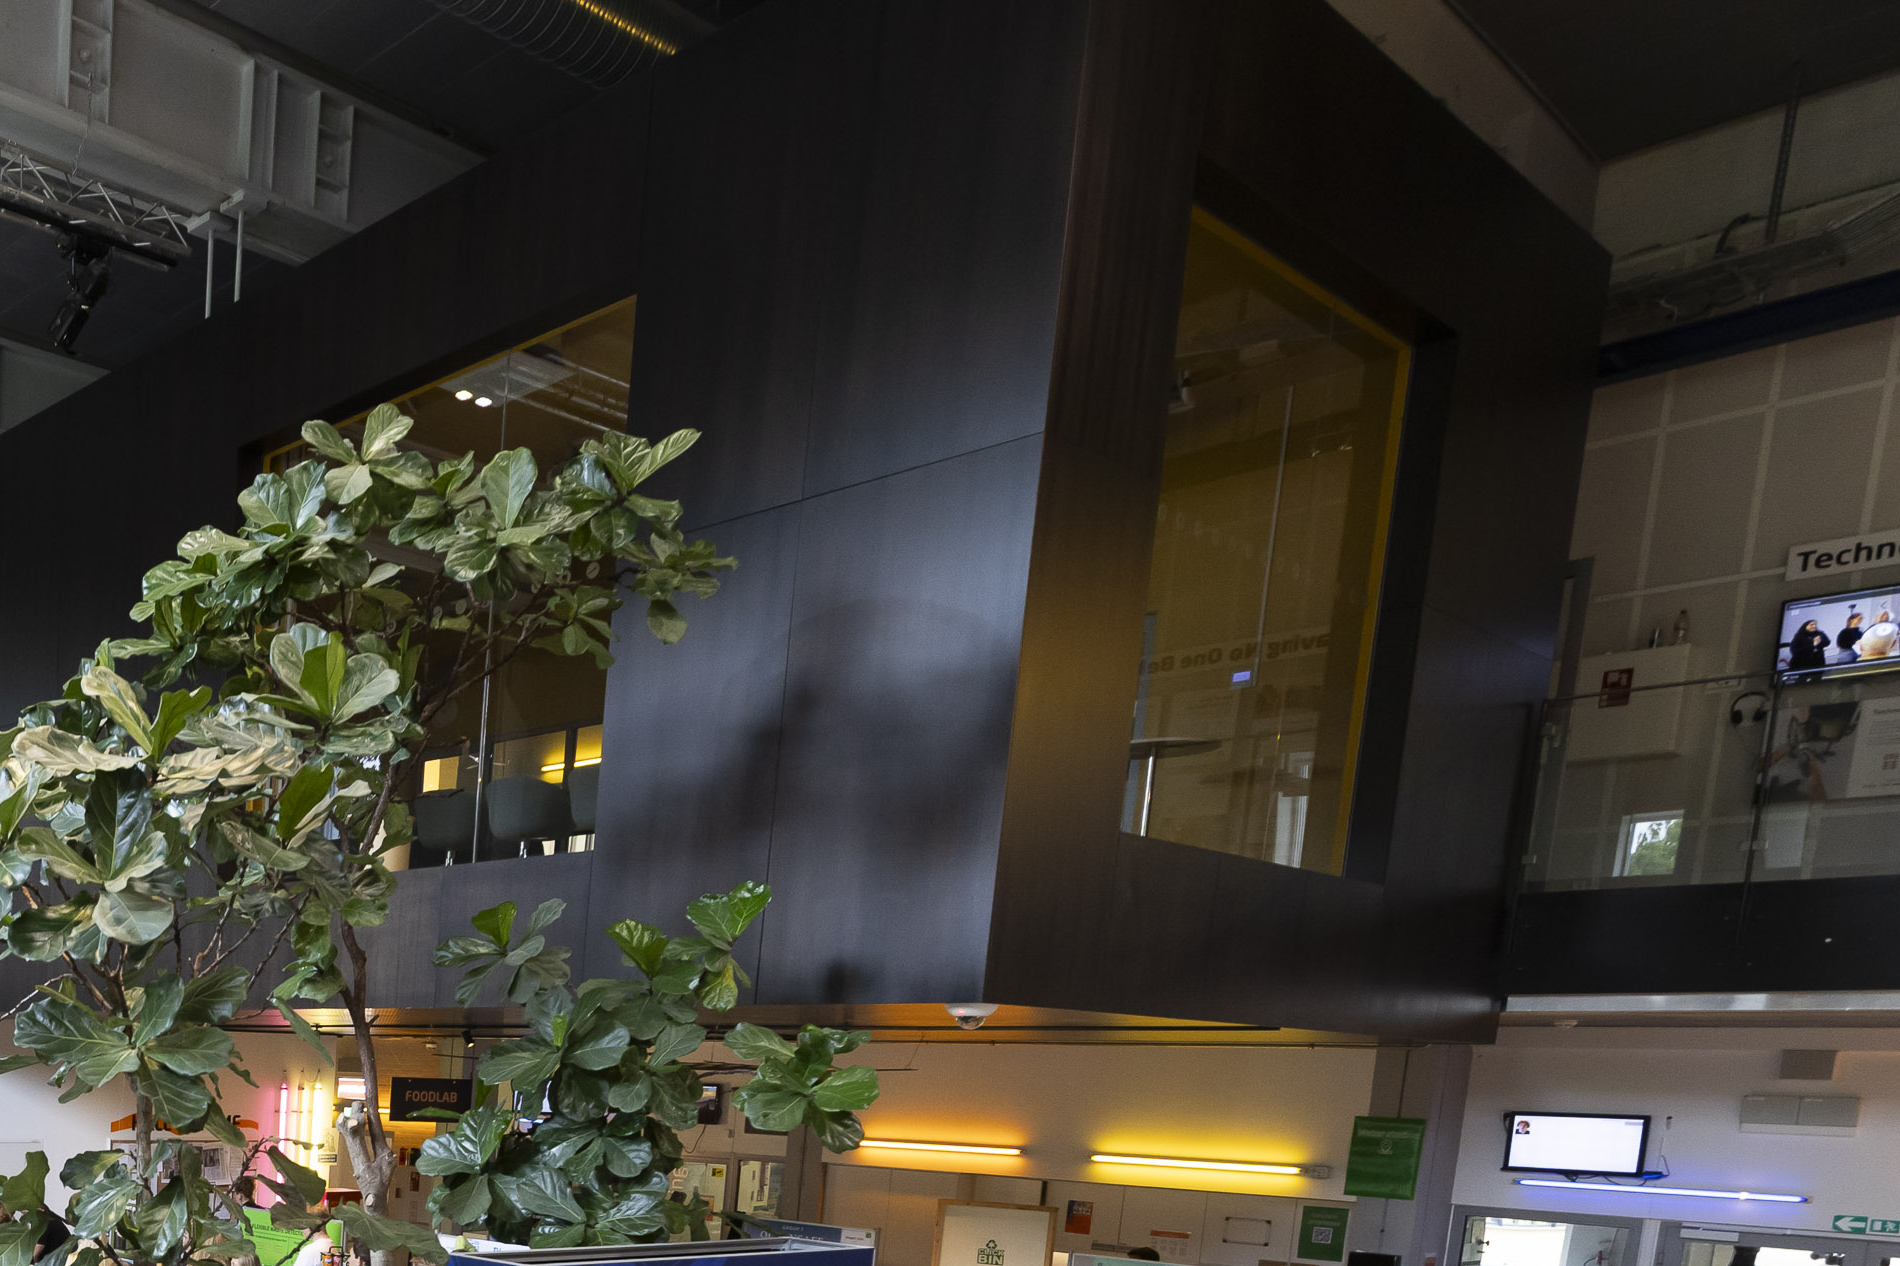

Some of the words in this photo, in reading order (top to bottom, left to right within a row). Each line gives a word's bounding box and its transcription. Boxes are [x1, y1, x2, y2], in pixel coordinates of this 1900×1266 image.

[1797, 542, 1900, 572] Techn
[405, 1091, 458, 1103] FOODLAB
[978, 1248, 1004, 1256] CLICK
[978, 1255, 1004, 1266] BIN
